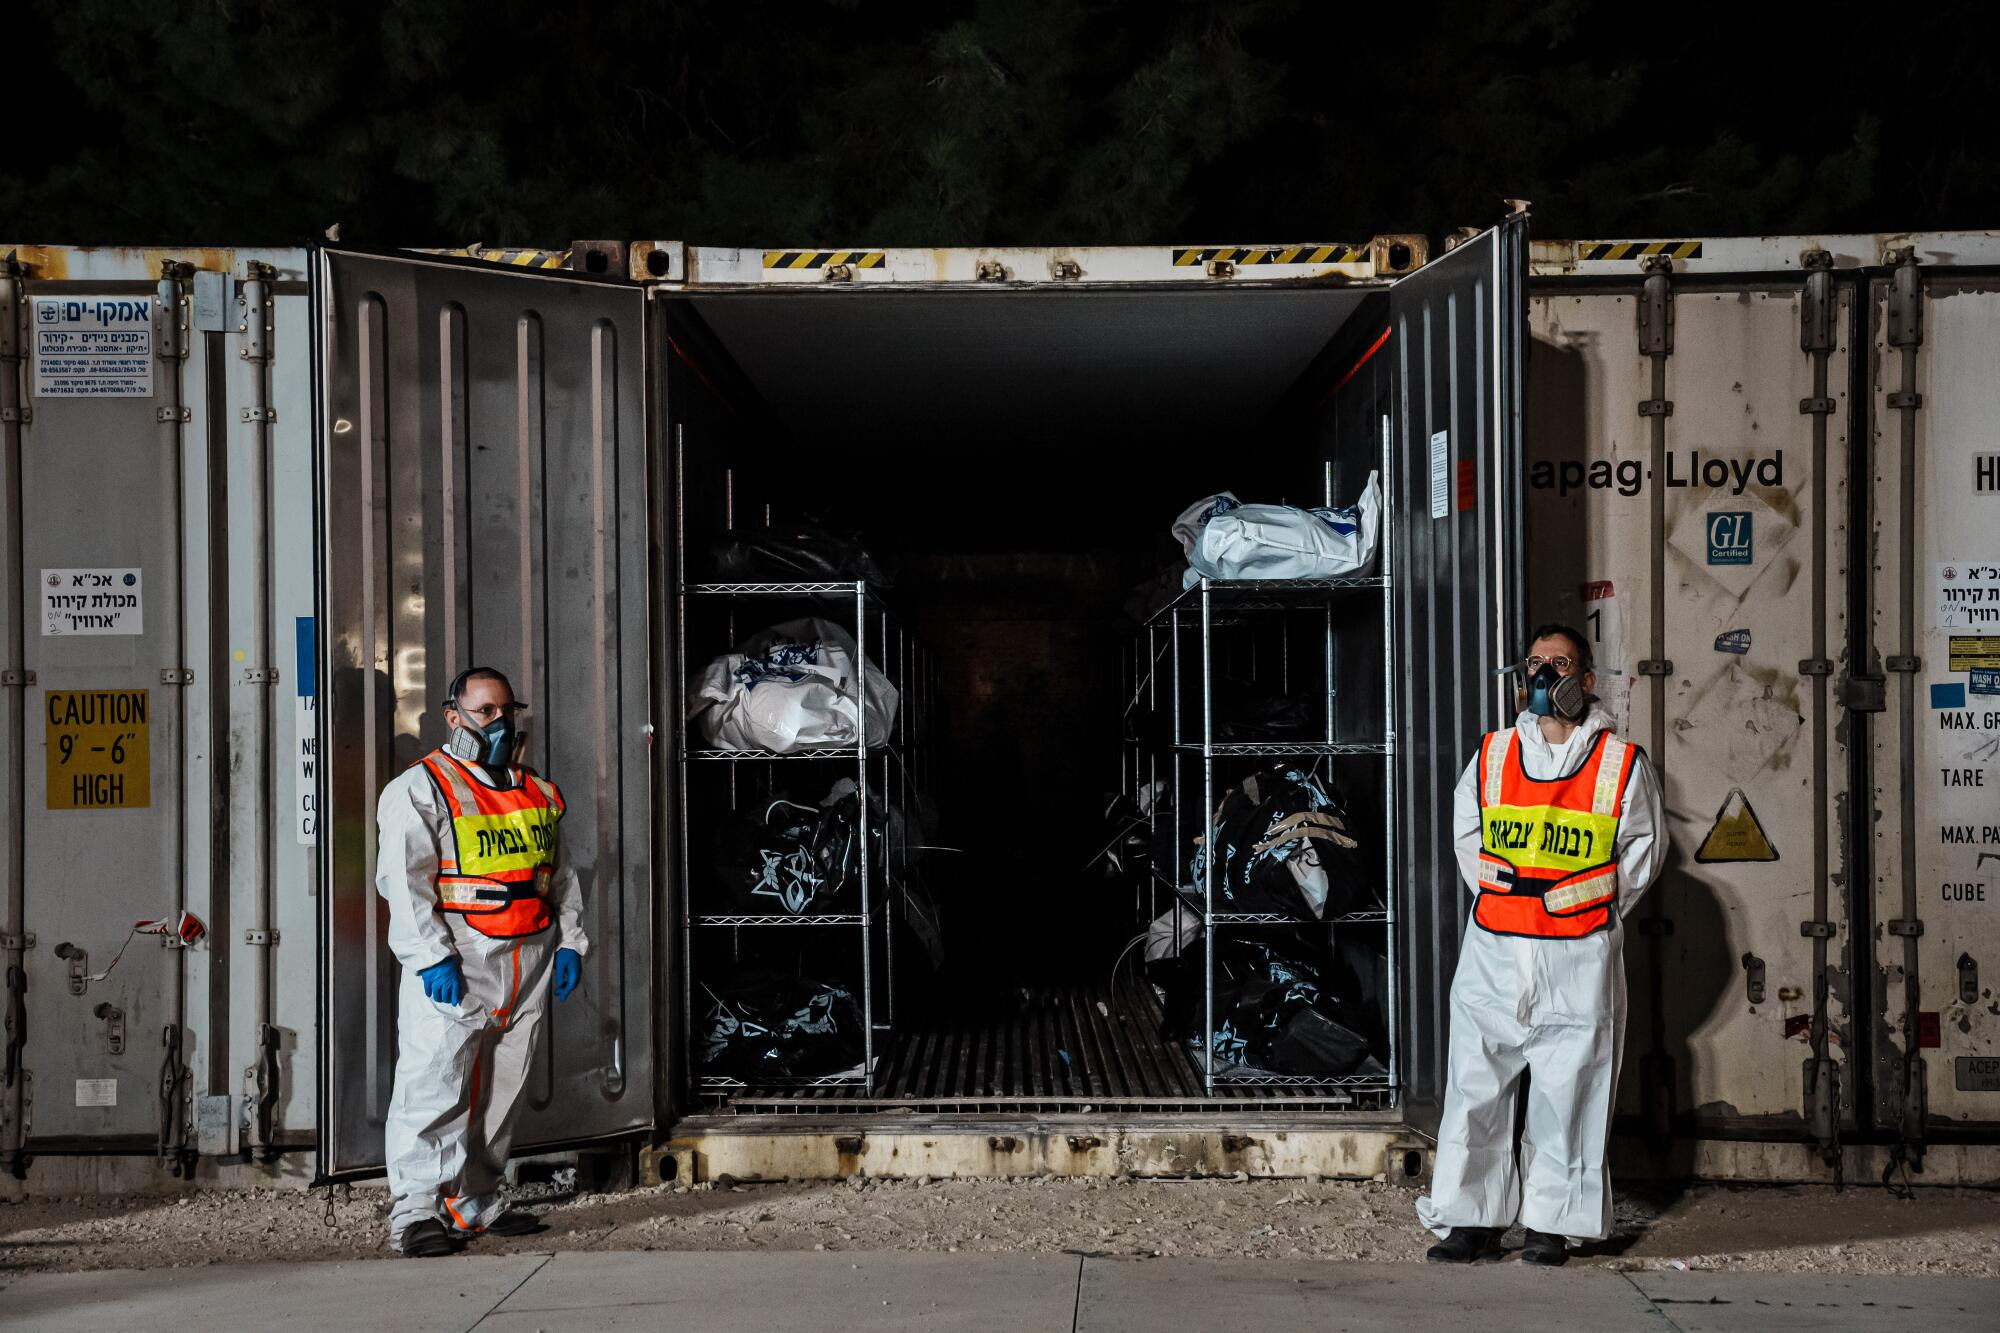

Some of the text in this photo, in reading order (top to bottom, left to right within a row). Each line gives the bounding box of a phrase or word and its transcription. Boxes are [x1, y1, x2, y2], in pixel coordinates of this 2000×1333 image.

[66, 301, 149, 327] אמקו-ים
[43, 333, 139, 345] מבנים ניידים קירור
[1976, 456, 2000, 491] H
[1710, 515, 1749, 549] GL
[1712, 549, 1748, 557] Certified
[47, 592, 137, 611] מכולת קירור
[1942, 588, 1984, 604] קירור
[1971, 673, 1992, 685] WASH
[49, 693, 146, 725] CAUTION
[1940, 712, 1980, 730] MAX.
[1941, 768, 1984, 787] TARE
[73, 773, 124, 806] HIGH
[476, 827, 528, 858] צבאית
[1540, 821, 1594, 858] רבנות
[1941, 826, 1979, 844] MAX.
[1941, 883, 1985, 901] CUBE
